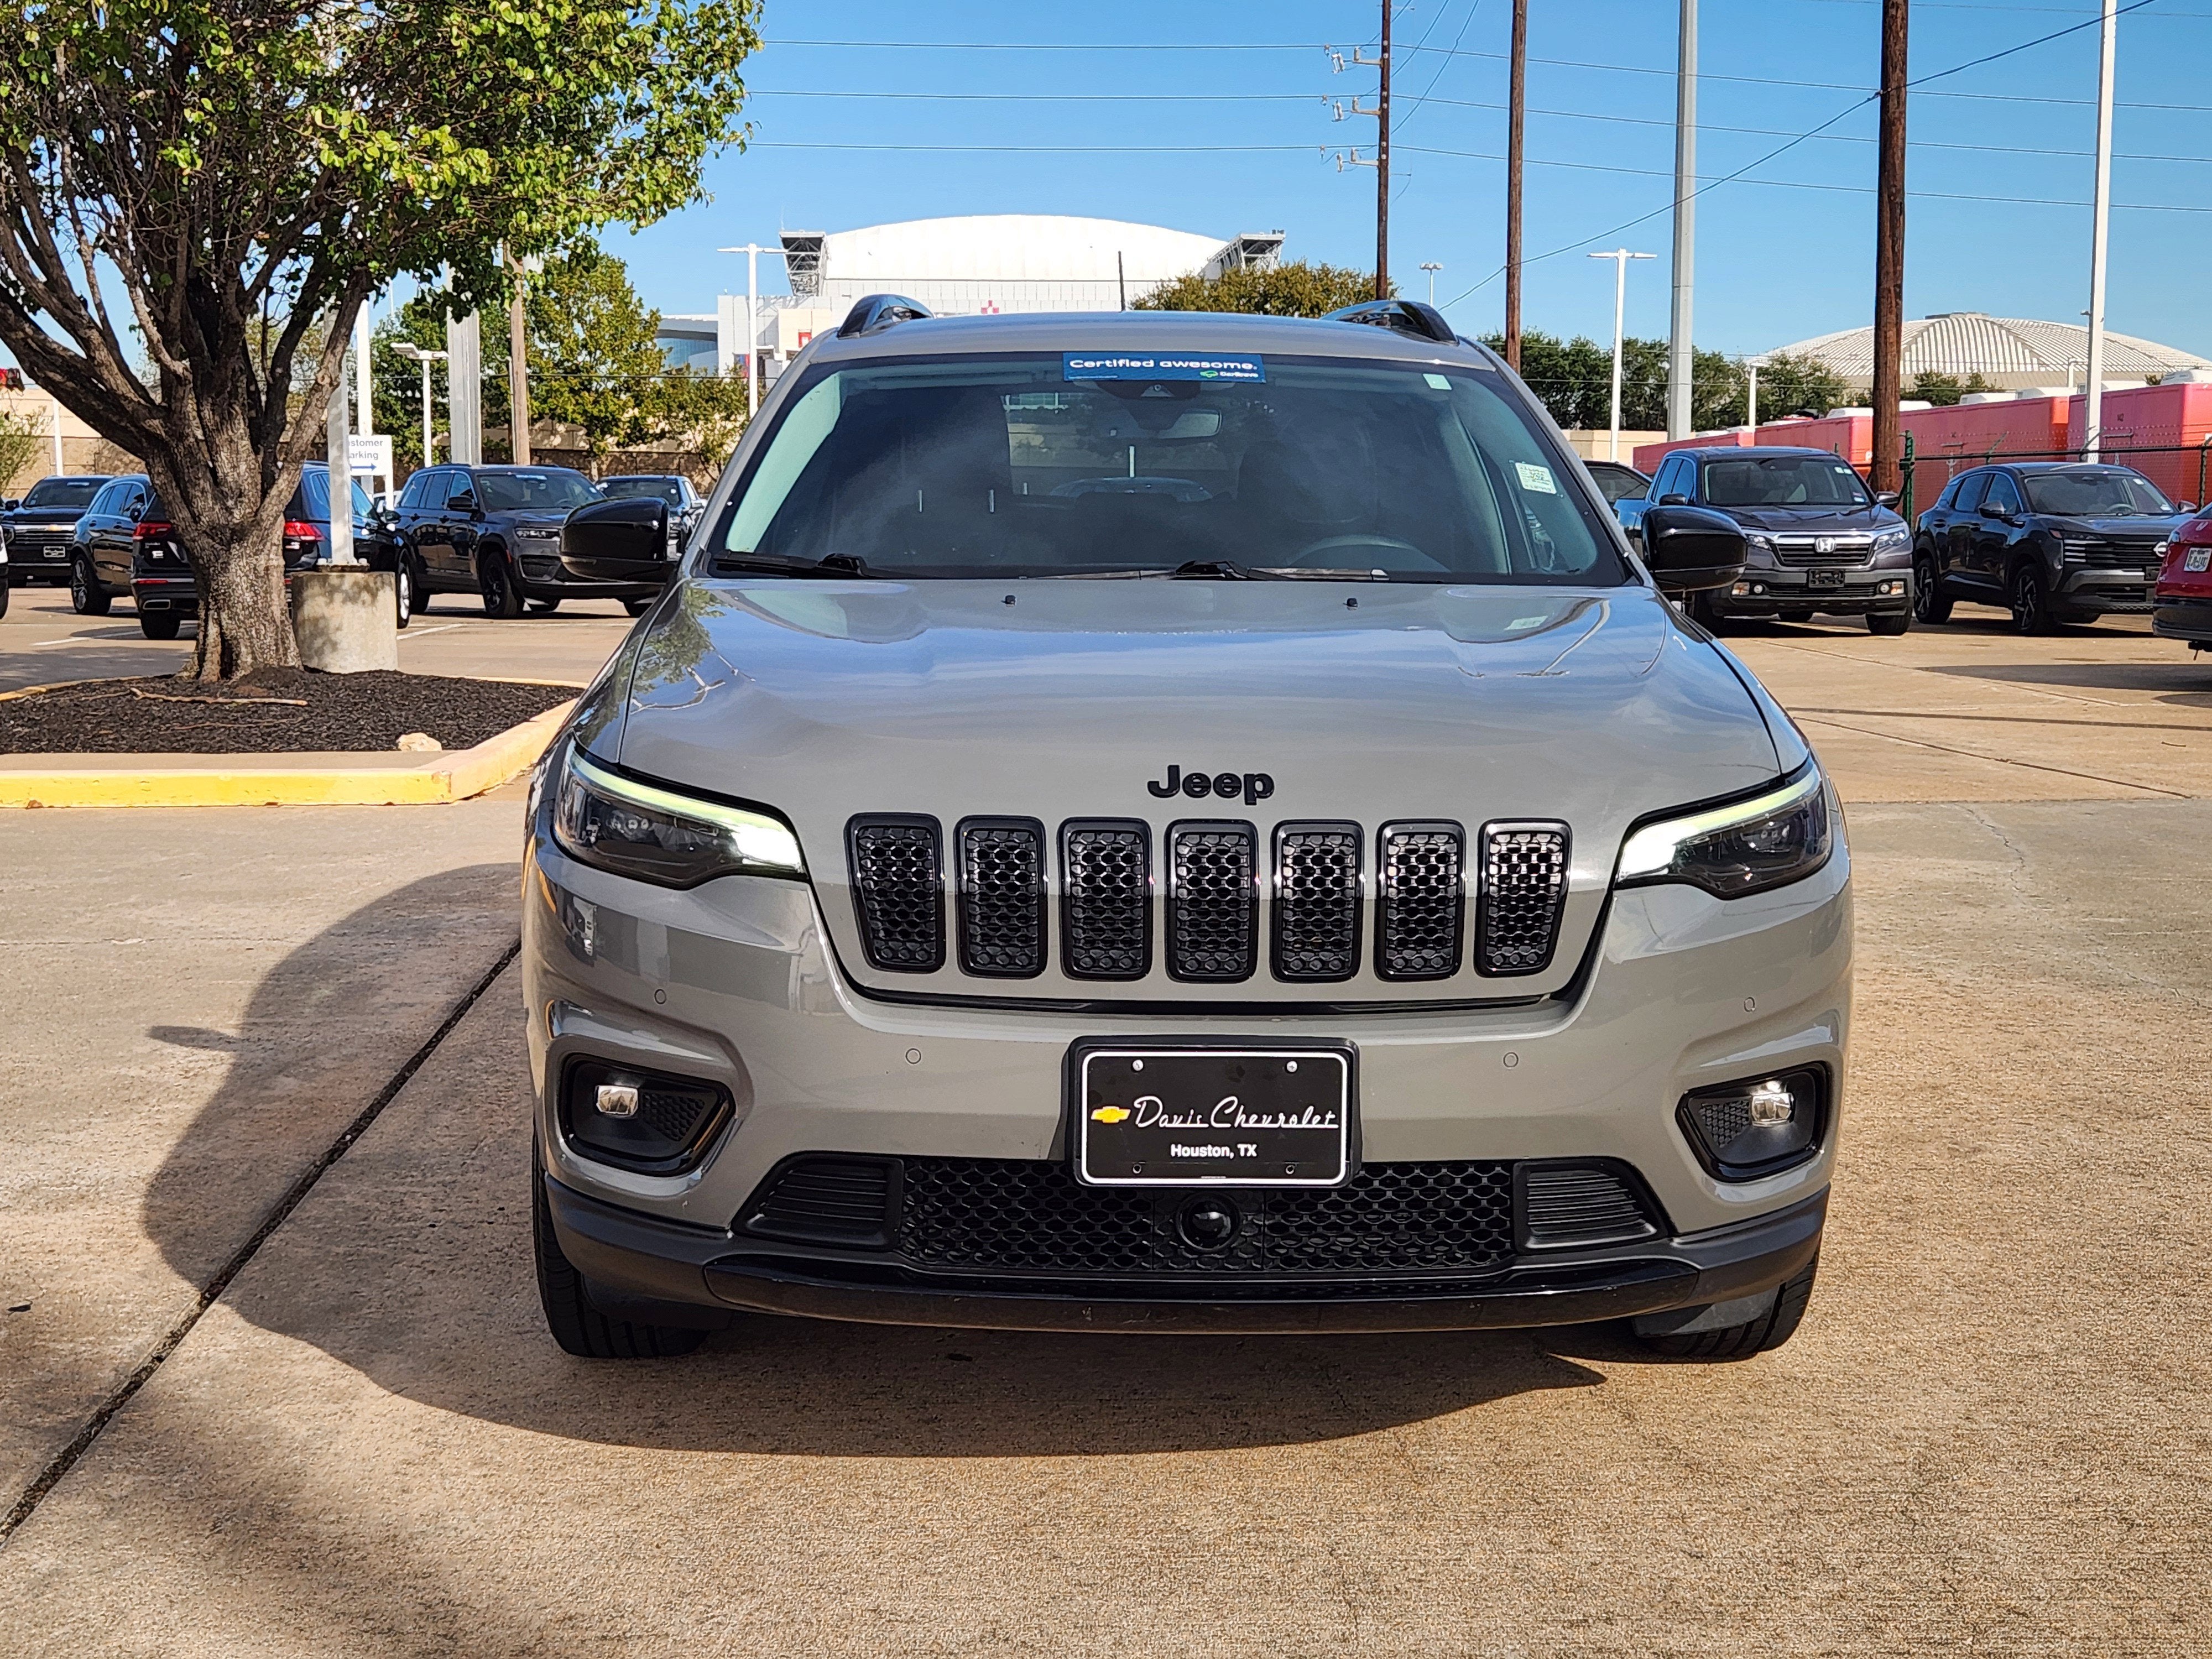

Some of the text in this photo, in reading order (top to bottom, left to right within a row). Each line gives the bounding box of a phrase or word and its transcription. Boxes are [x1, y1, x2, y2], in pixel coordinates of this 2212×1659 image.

[1070, 358, 1258, 370] Certified awesome.
[348, 439, 383, 447] stomer
[348, 451, 379, 460] arking
[1147, 765, 1275, 806] Jeep
[1134, 1095, 1339, 1128] Davis Chevrolet
[1170, 1144, 1258, 1159] Houston, TX
